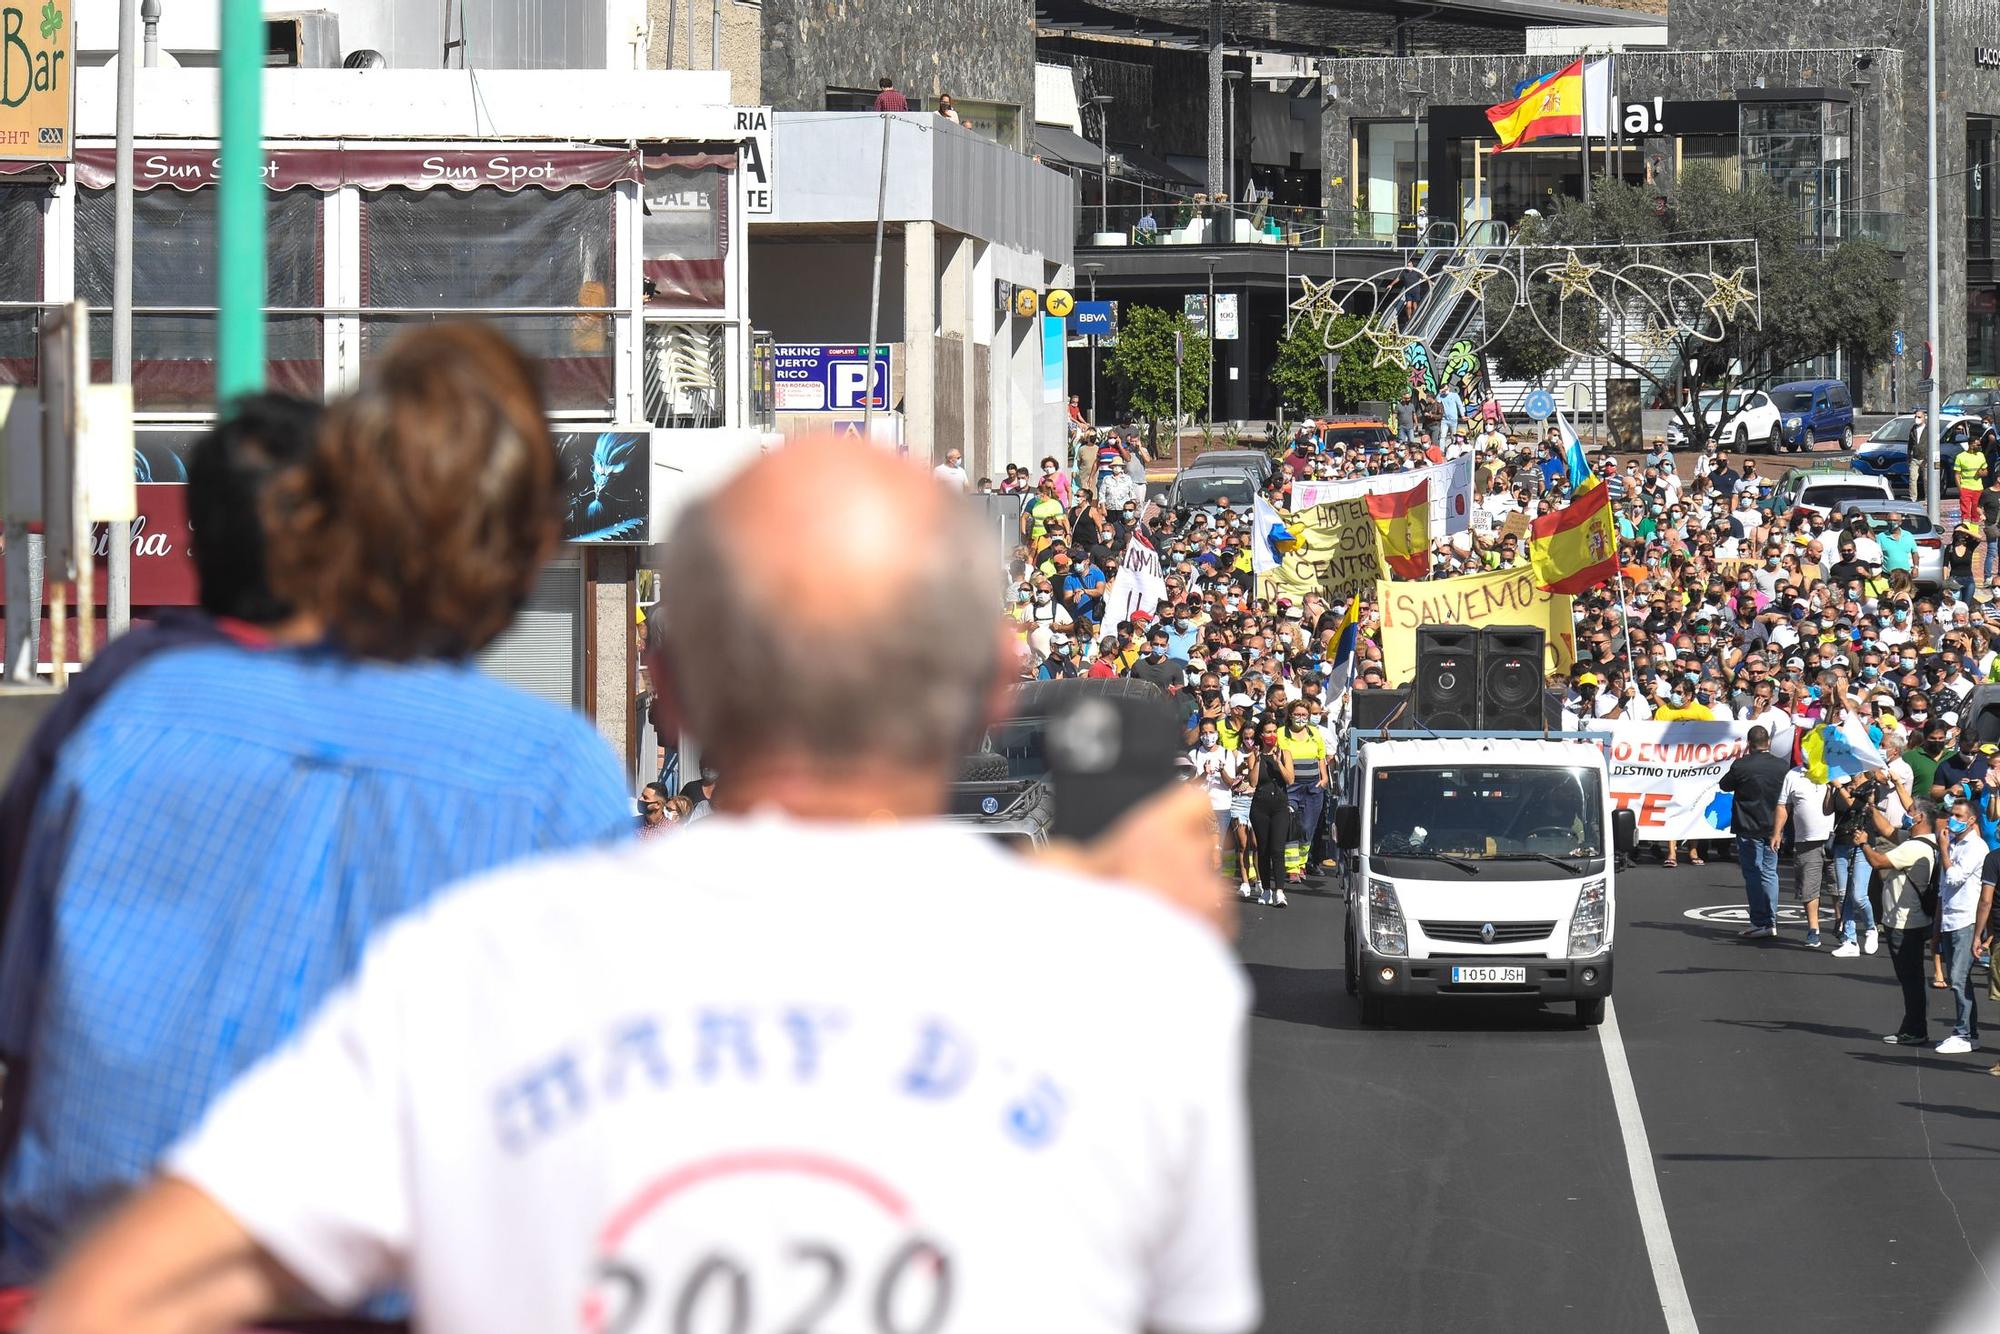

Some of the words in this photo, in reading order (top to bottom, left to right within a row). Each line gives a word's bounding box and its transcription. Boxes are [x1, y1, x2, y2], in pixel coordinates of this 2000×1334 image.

[1, 7, 65, 108] Bar
[143, 155, 202, 178] Sun
[420, 156, 478, 179] Sun
[486, 157, 555, 186] Spot
[1079, 313, 1107, 323] BBVA
[774, 347, 821, 356] ARKING
[775, 359, 818, 367] UERTO
[776, 370, 809, 379] RICO
[1638, 742, 1669, 763] EN
[1674, 737, 1750, 763] MOGÁ
[1613, 765, 1663, 778] DESTINO
[1667, 765, 1721, 778] TURÍSTICO
[1463, 969, 1497, 981] 1050
[1500, 969, 1524, 981] JSH
[588, 1232, 958, 1334] 2020
